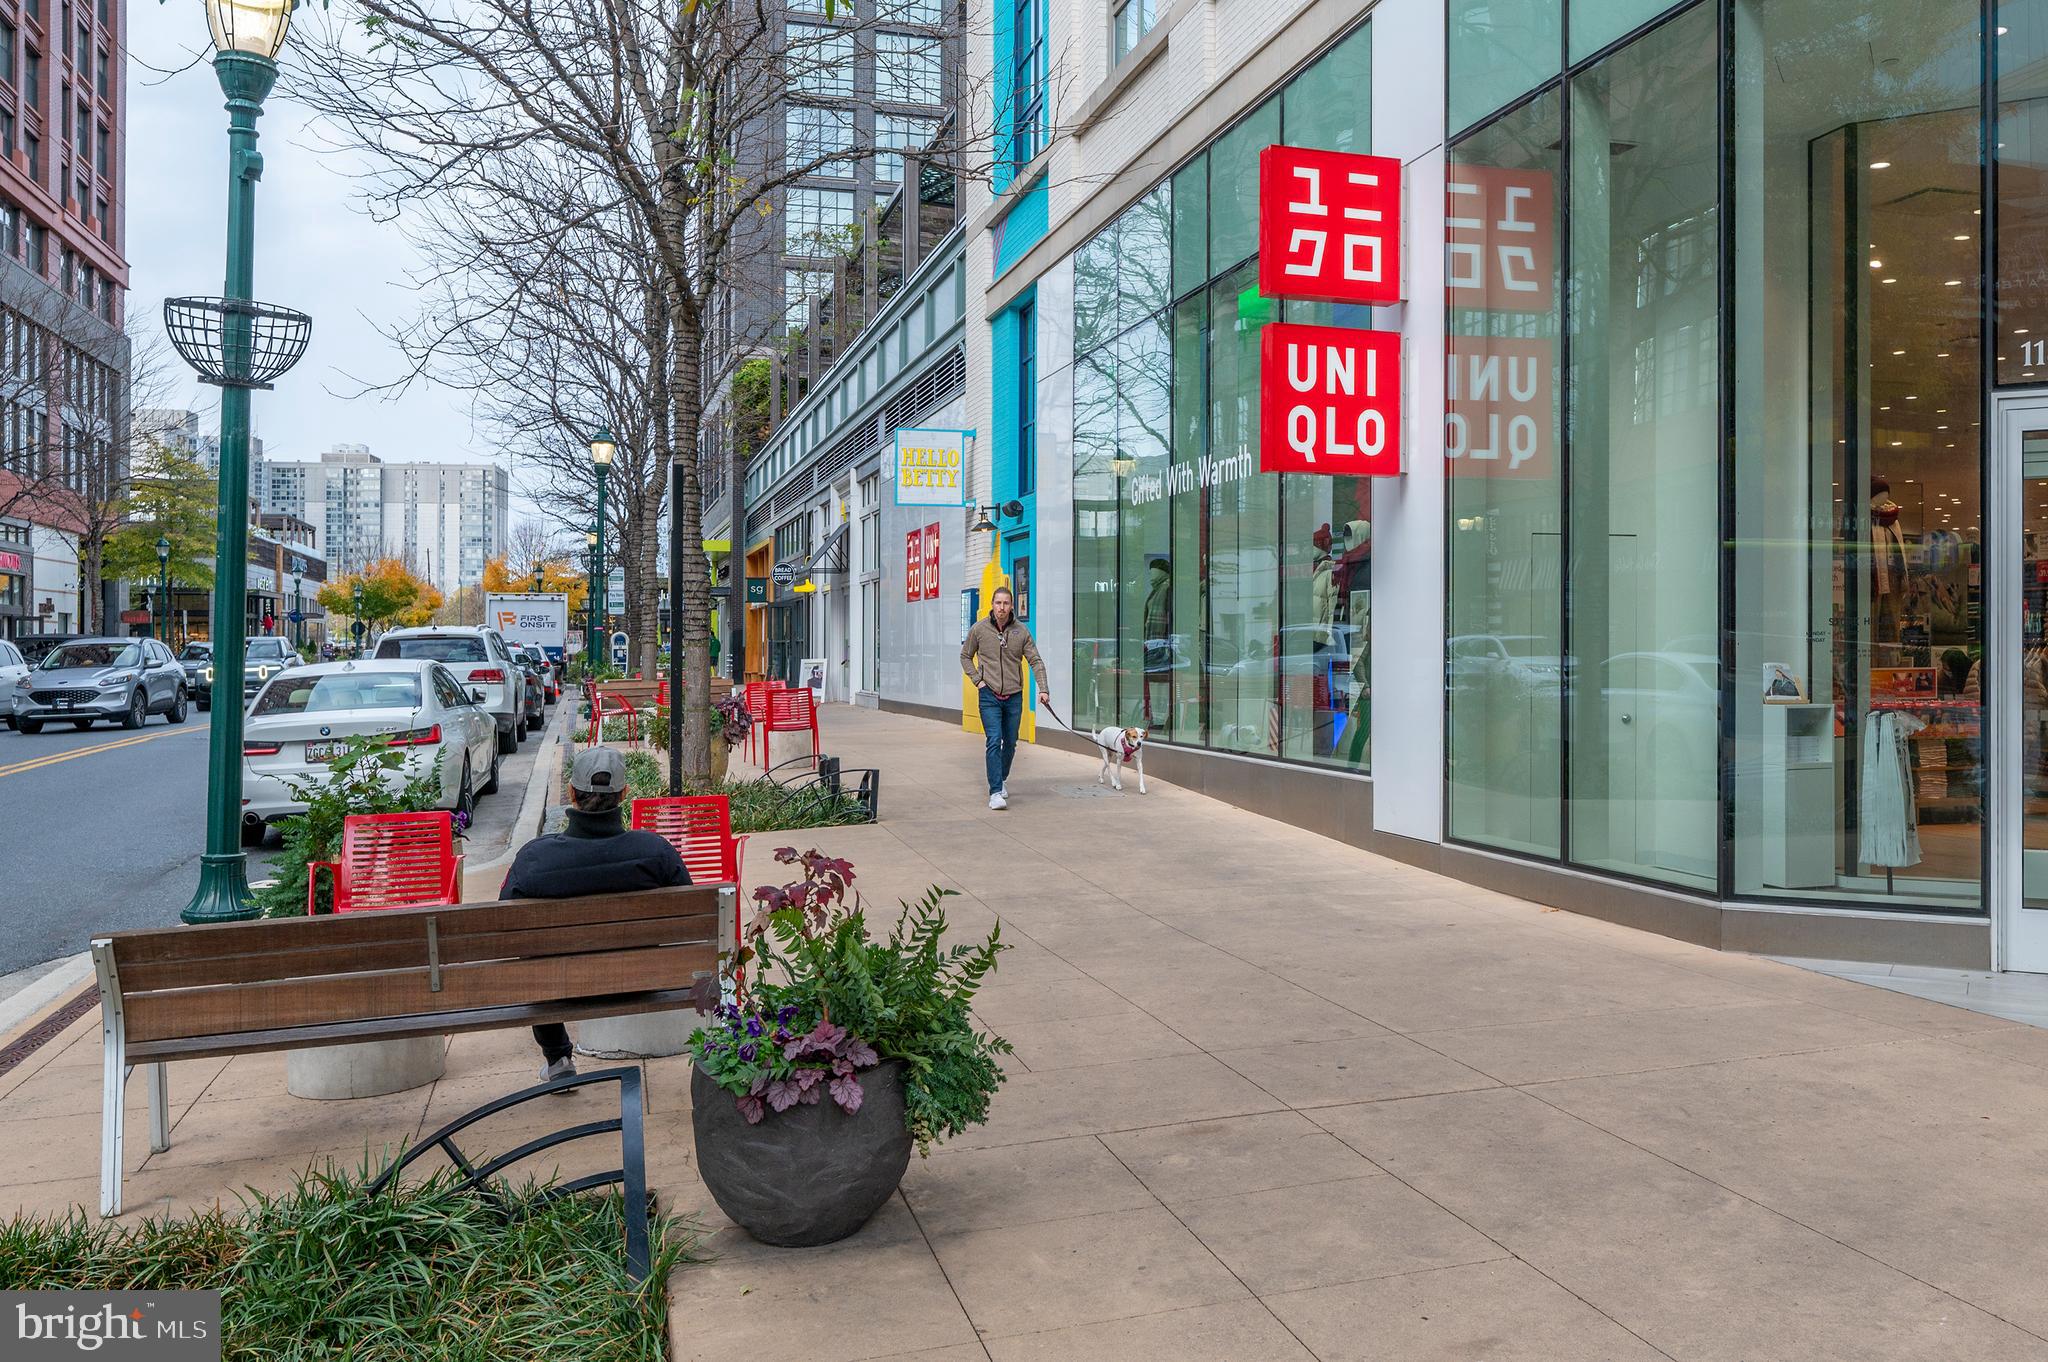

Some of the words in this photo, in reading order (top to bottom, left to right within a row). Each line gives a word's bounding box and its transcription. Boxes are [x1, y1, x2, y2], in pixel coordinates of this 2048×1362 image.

[2020, 339, 2048, 367] 11
[1287, 343, 1377, 397] UNI
[1287, 404, 1386, 463] QLO
[901, 447, 960, 467] HELLO
[901, 468, 959, 487] BETTY
[1131, 470, 1162, 506] Gifted
[1166, 460, 1194, 497] With
[1198, 443, 1252, 489] Warmth
[750, 585, 764, 595] sg
[925, 563, 938, 594] QLO
[519, 621, 558, 629] ONSITE
[520, 614, 551, 622] FIRST
